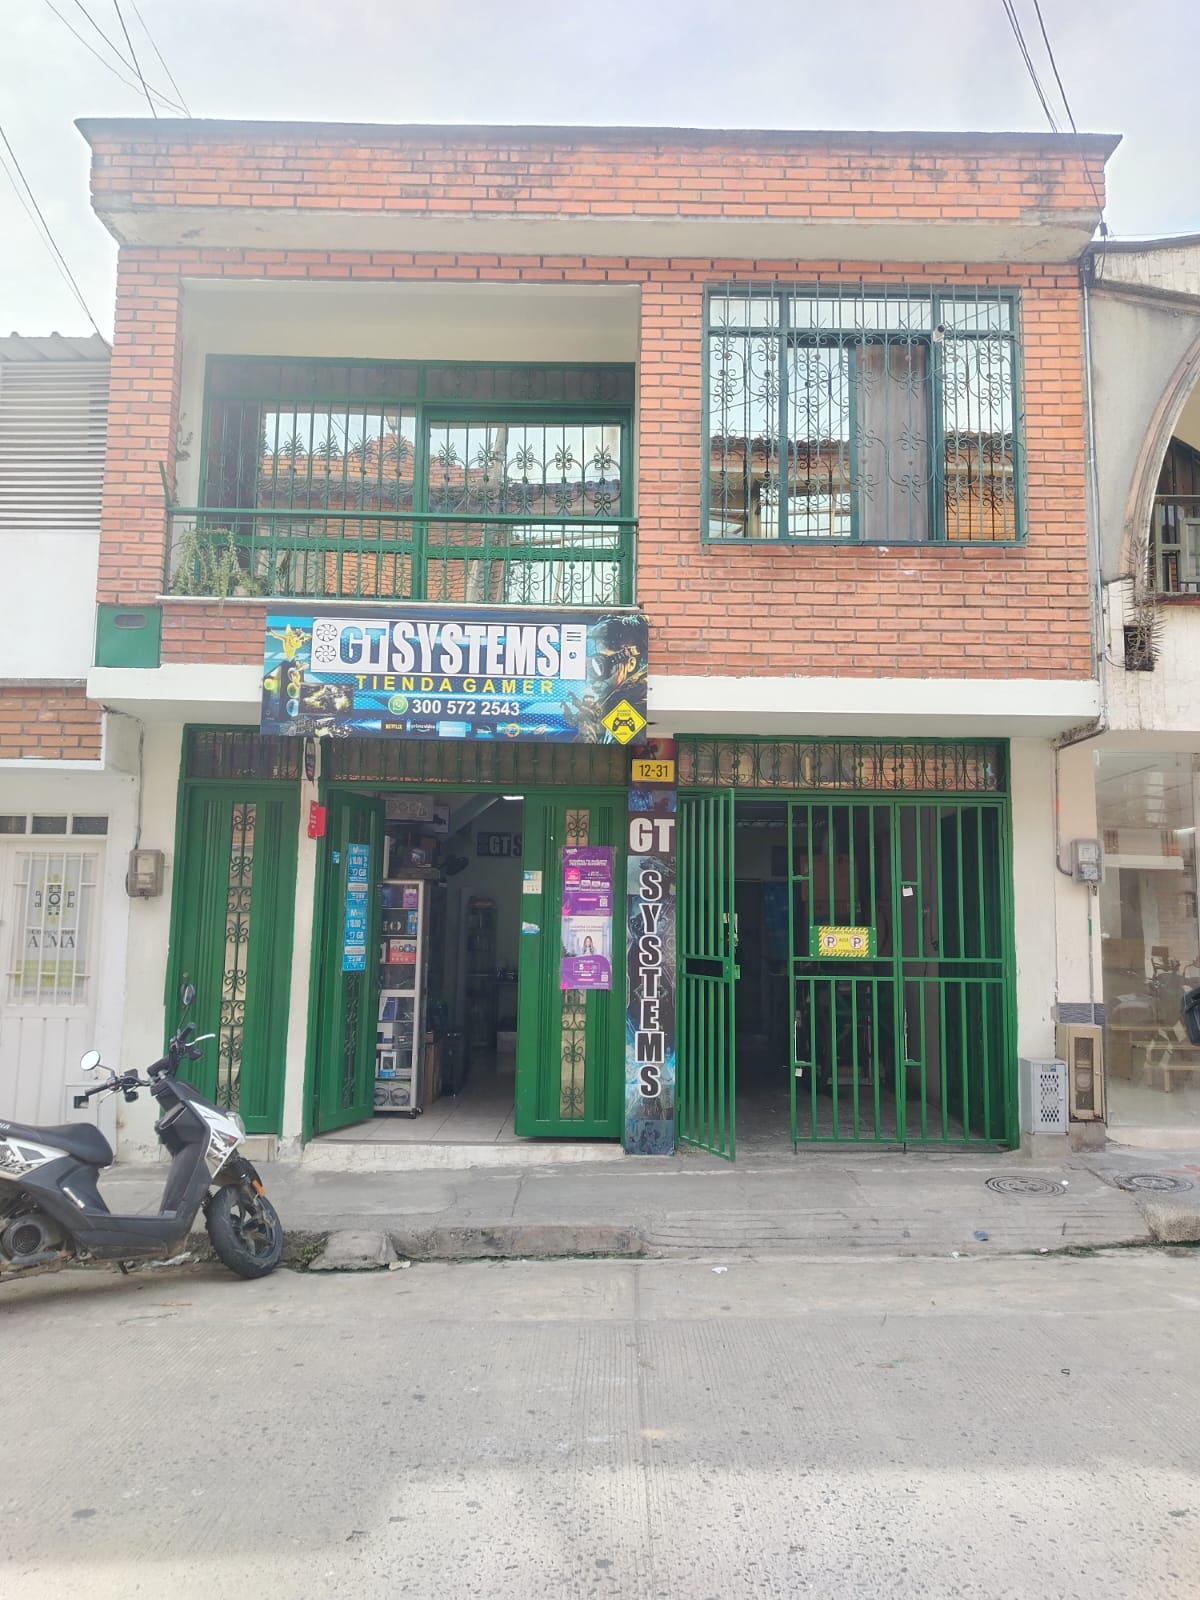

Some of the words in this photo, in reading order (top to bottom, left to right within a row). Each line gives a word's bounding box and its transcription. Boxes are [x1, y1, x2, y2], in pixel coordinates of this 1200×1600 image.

[340, 626, 386, 665] GT
[392, 621, 560, 677] SYSTEMS
[355, 674, 453, 692] TIENDA
[463, 677, 553, 695] GAMER
[412, 699, 442, 714] 300
[446, 701, 476, 715] 572
[481, 702, 520, 716] 2543
[639, 764, 669, 777] 12-31
[629, 817, 675, 853] GT
[635, 869, 665, 1098] SYSTEMS
